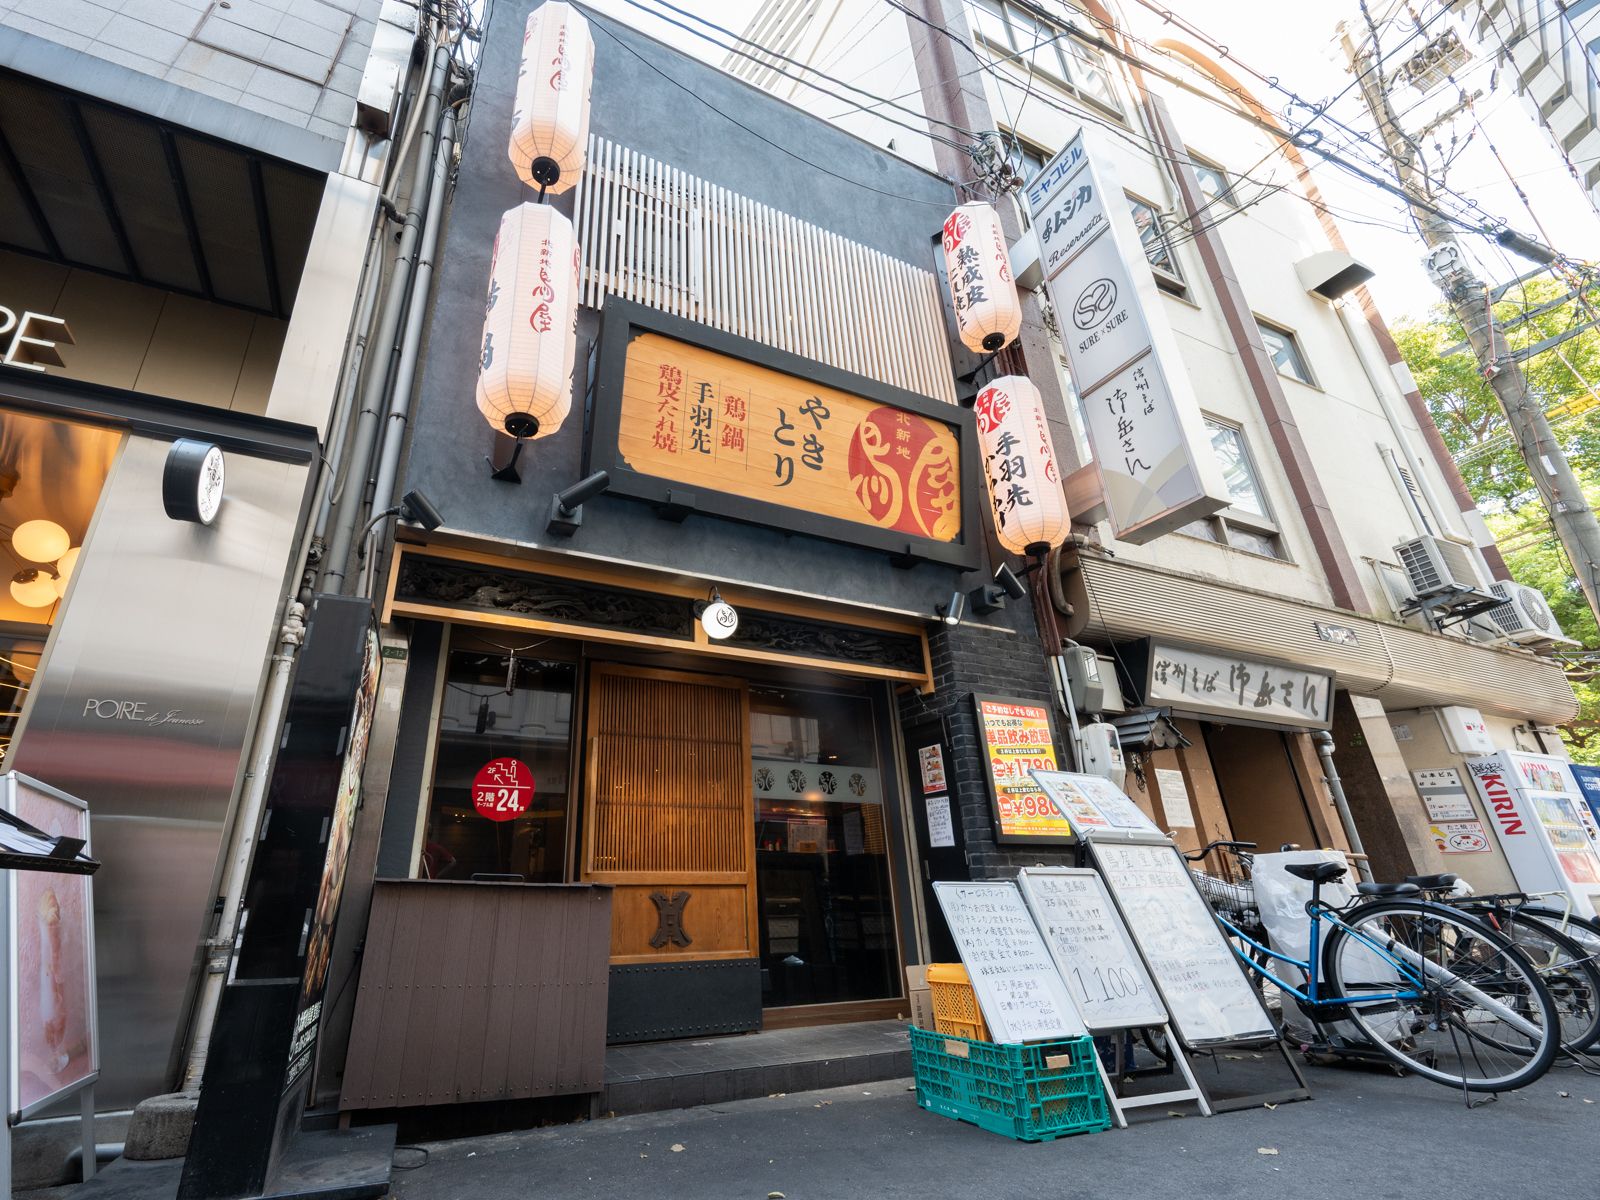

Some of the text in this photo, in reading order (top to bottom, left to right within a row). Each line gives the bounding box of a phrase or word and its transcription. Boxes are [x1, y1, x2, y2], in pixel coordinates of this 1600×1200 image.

[1030, 147, 1082, 206] ミヤコビル
[957, 245, 989, 311] 熟成皮
[1079, 331, 1101, 353] SURE
[1106, 309, 1129, 331] SURE
[652, 364, 682, 453] 鶏皮たれ焼
[690, 382, 714, 454] 手羽先
[720, 395, 746, 452] 鶏鍋
[895, 412, 911, 459] 北新地
[996, 431, 1033, 513] 手羽先
[83, 699, 147, 720] POIRE
[986, 728, 1052, 745] 単品飲み放題
[477, 792, 495, 802] 2階
[1479, 774, 1526, 835] KIRIN
